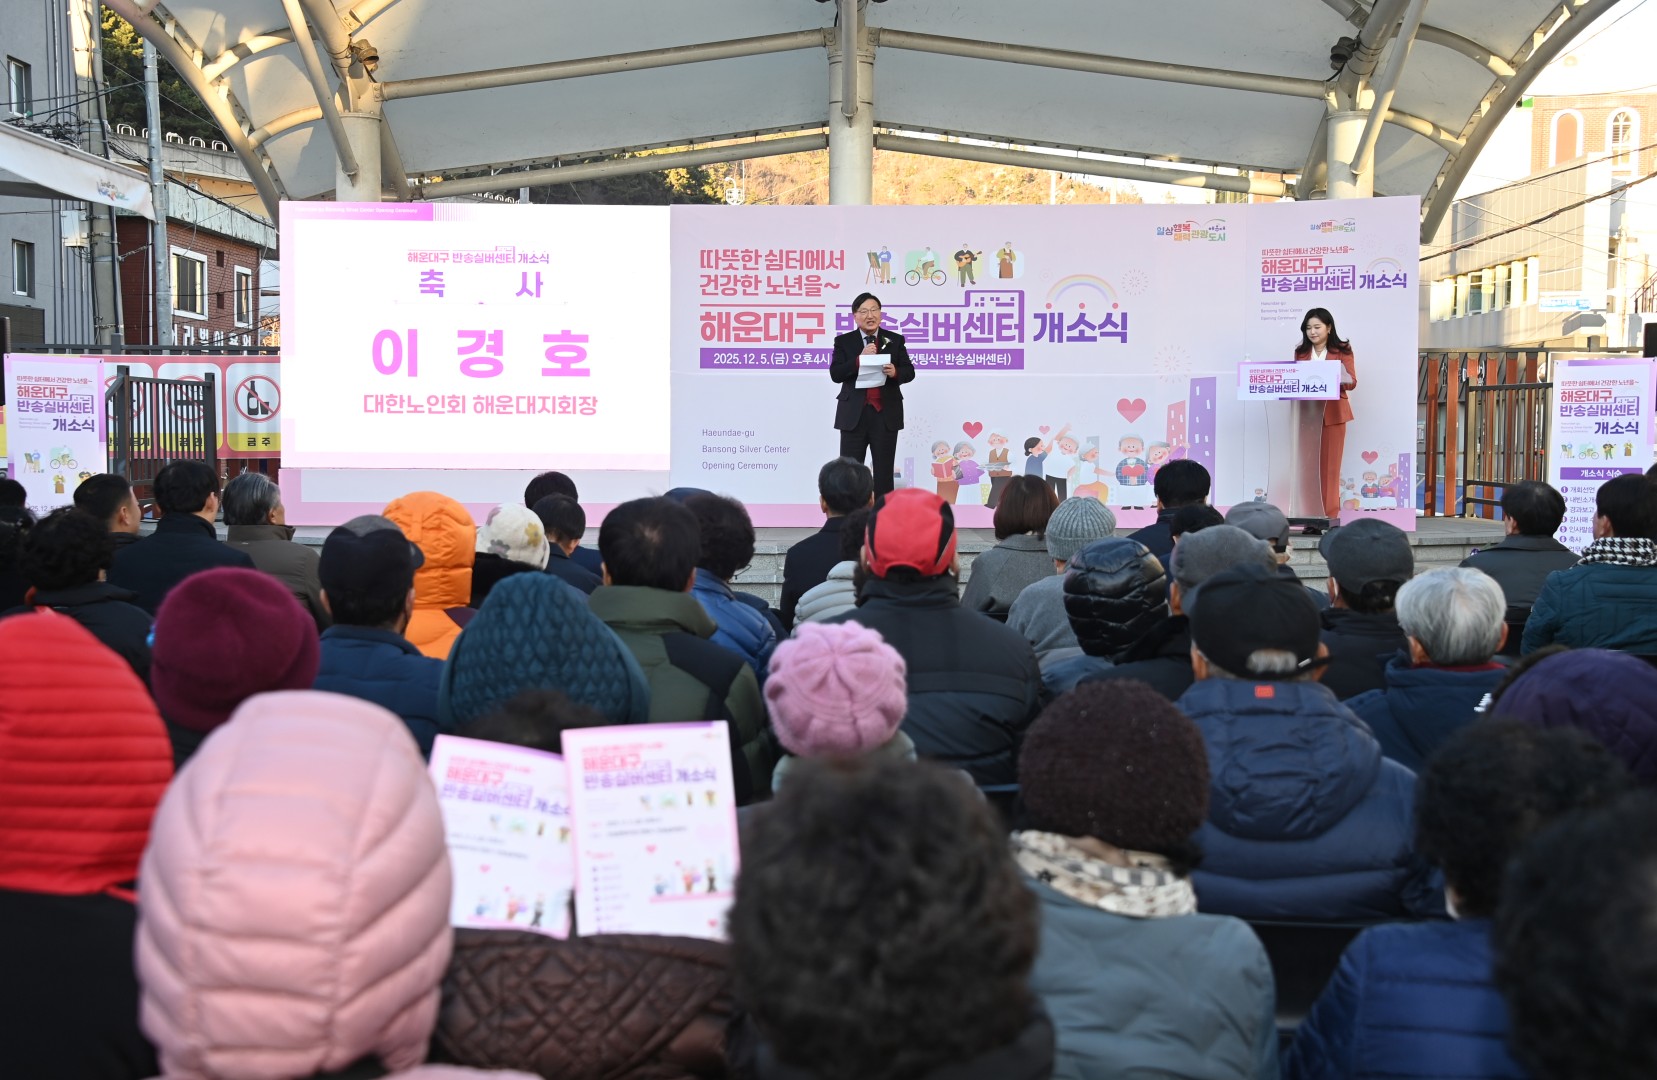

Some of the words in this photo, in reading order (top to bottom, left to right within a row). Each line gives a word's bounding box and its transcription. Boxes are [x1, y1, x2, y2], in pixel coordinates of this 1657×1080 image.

[407, 252, 450, 264] 해운대구
[452, 250, 516, 264] 반송실버센터
[518, 252, 550, 264] 개소식
[1309, 246, 1329, 254] 건강한
[700, 249, 762, 271] 따뜻한
[764, 249, 845, 271] 쉼터에서
[1261, 258, 1324, 275] 해운대구
[419, 269, 445, 297] 축
[515, 271, 544, 298] 사
[700, 274, 762, 297] 건강한
[764, 274, 841, 297] 노년을~
[1261, 272, 1356, 293] 반송실버센터
[1359, 272, 1407, 290] 개소식
[699, 311, 826, 344] 해운대구
[1033, 311, 1128, 344] 개소식
[791, 353, 830, 367] 오후4시
[1249, 374, 1282, 384] 해운대구
[16, 385, 69, 400] 해운대구
[1249, 383, 1300, 394] 반송실버센터
[1301, 384, 1327, 393] 개소식
[1560, 390, 1613, 402] 해운대구
[17, 399, 95, 414] 반송실버센터
[363, 394, 466, 414] 대한노인회
[472, 394, 599, 416] 해운대지회장
[1560, 403, 1640, 417] 반송실버센터
[52, 418, 95, 432] 개소식
[1594, 421, 1639, 435] 개소식
[702, 429, 755, 438] Haeundae-gu
[702, 445, 737, 454] Bansong
[739, 445, 762, 453] Silver
[764, 445, 790, 453] Center
[701, 461, 735, 470] Opening
[737, 461, 778, 471] Ceremony
[1580, 470, 1604, 478] 개소식
[1570, 486, 1596, 494] 개회선언
[1570, 496, 1595, 504] 내빈소개
[1570, 506, 1594, 514] 경과보고
